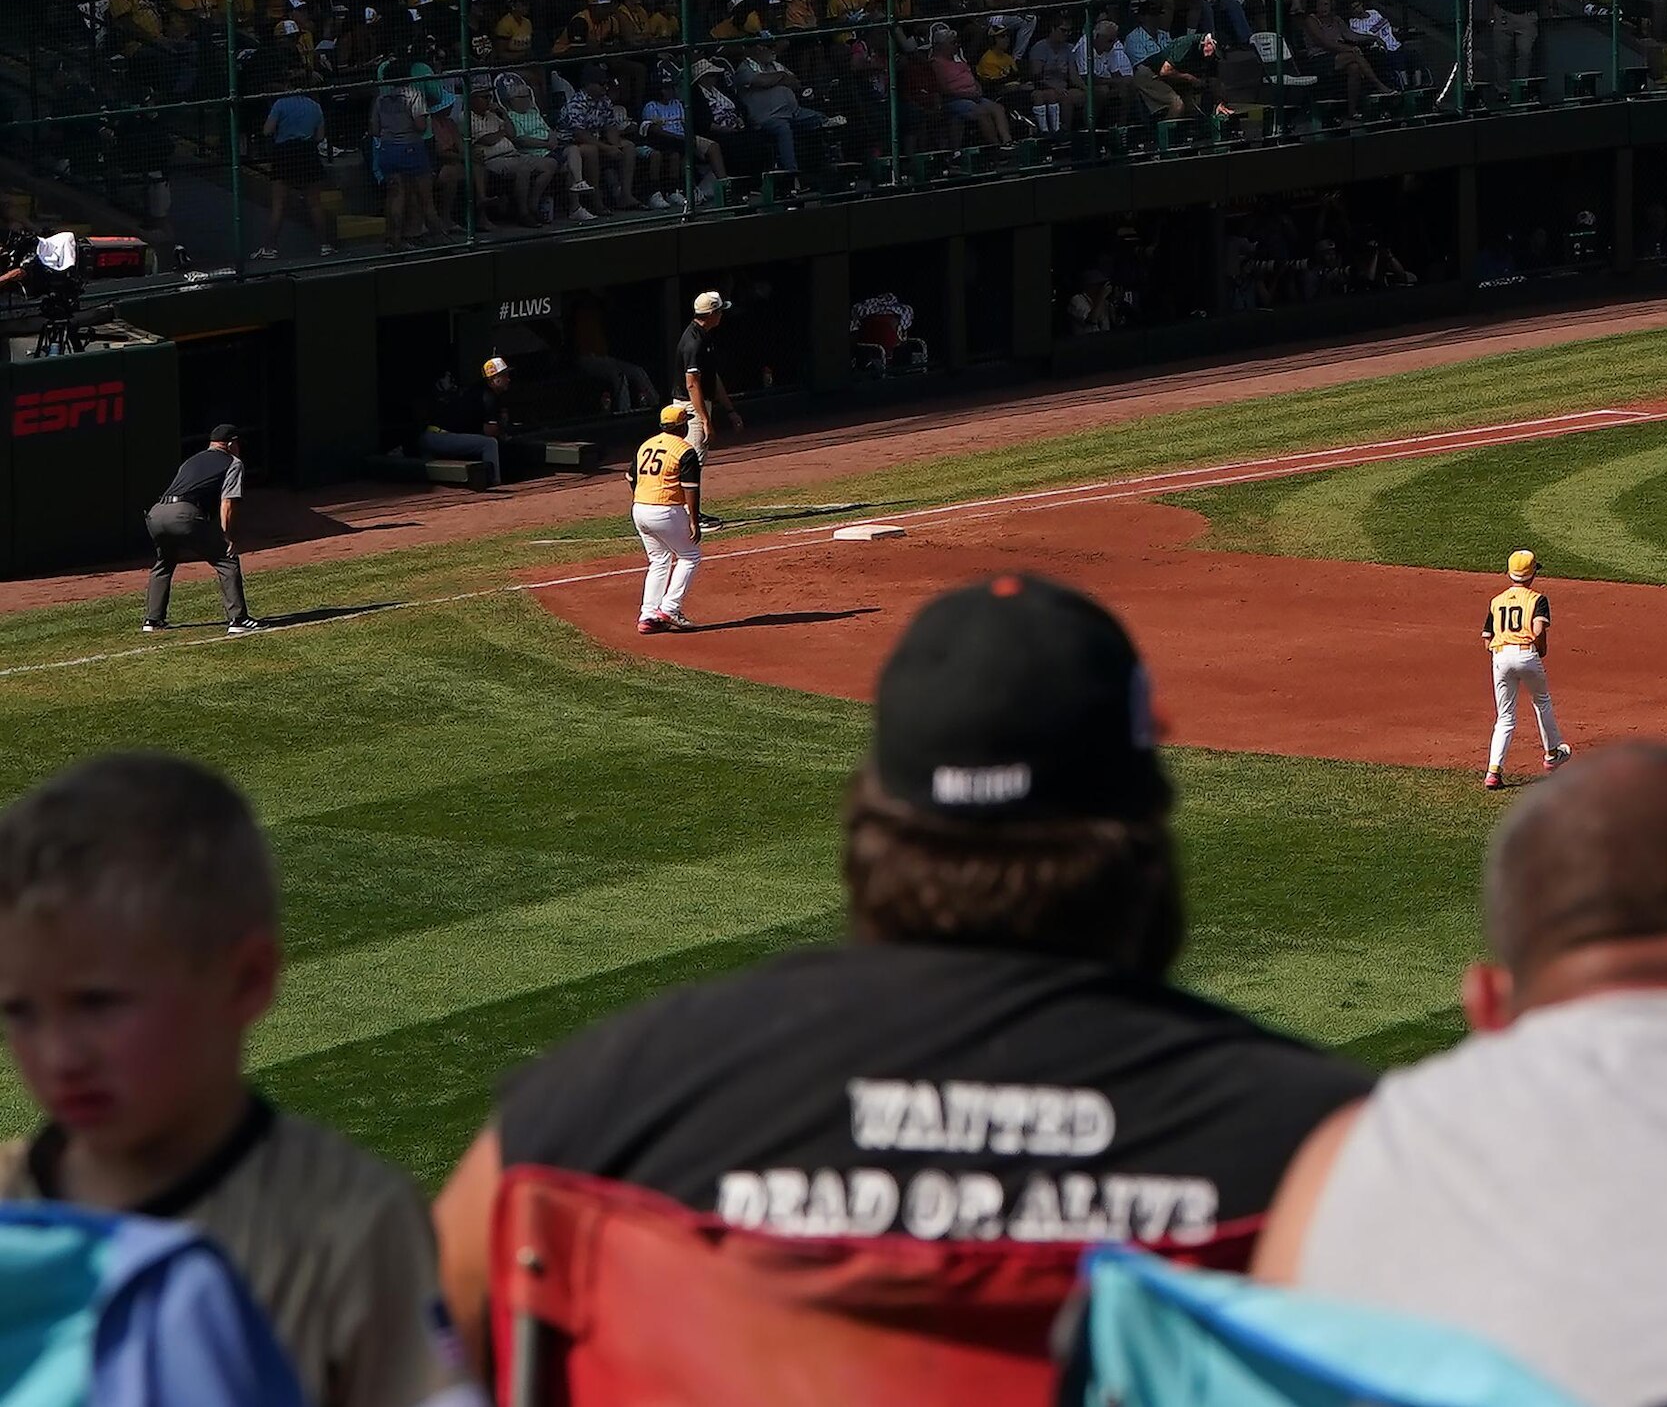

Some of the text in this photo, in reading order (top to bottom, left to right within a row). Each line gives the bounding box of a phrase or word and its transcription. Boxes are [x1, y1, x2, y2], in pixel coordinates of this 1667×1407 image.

[97, 252, 139, 267] ESPN
[499, 297, 552, 320] #LLWS
[13, 381, 126, 438] ESPN
[639, 448, 667, 476] 25
[1498, 605, 1523, 633] 10
[848, 1078, 1116, 1157] WANTED
[717, 1167, 899, 1239] DEAD
[1009, 1172, 1219, 1245] ALIVE
